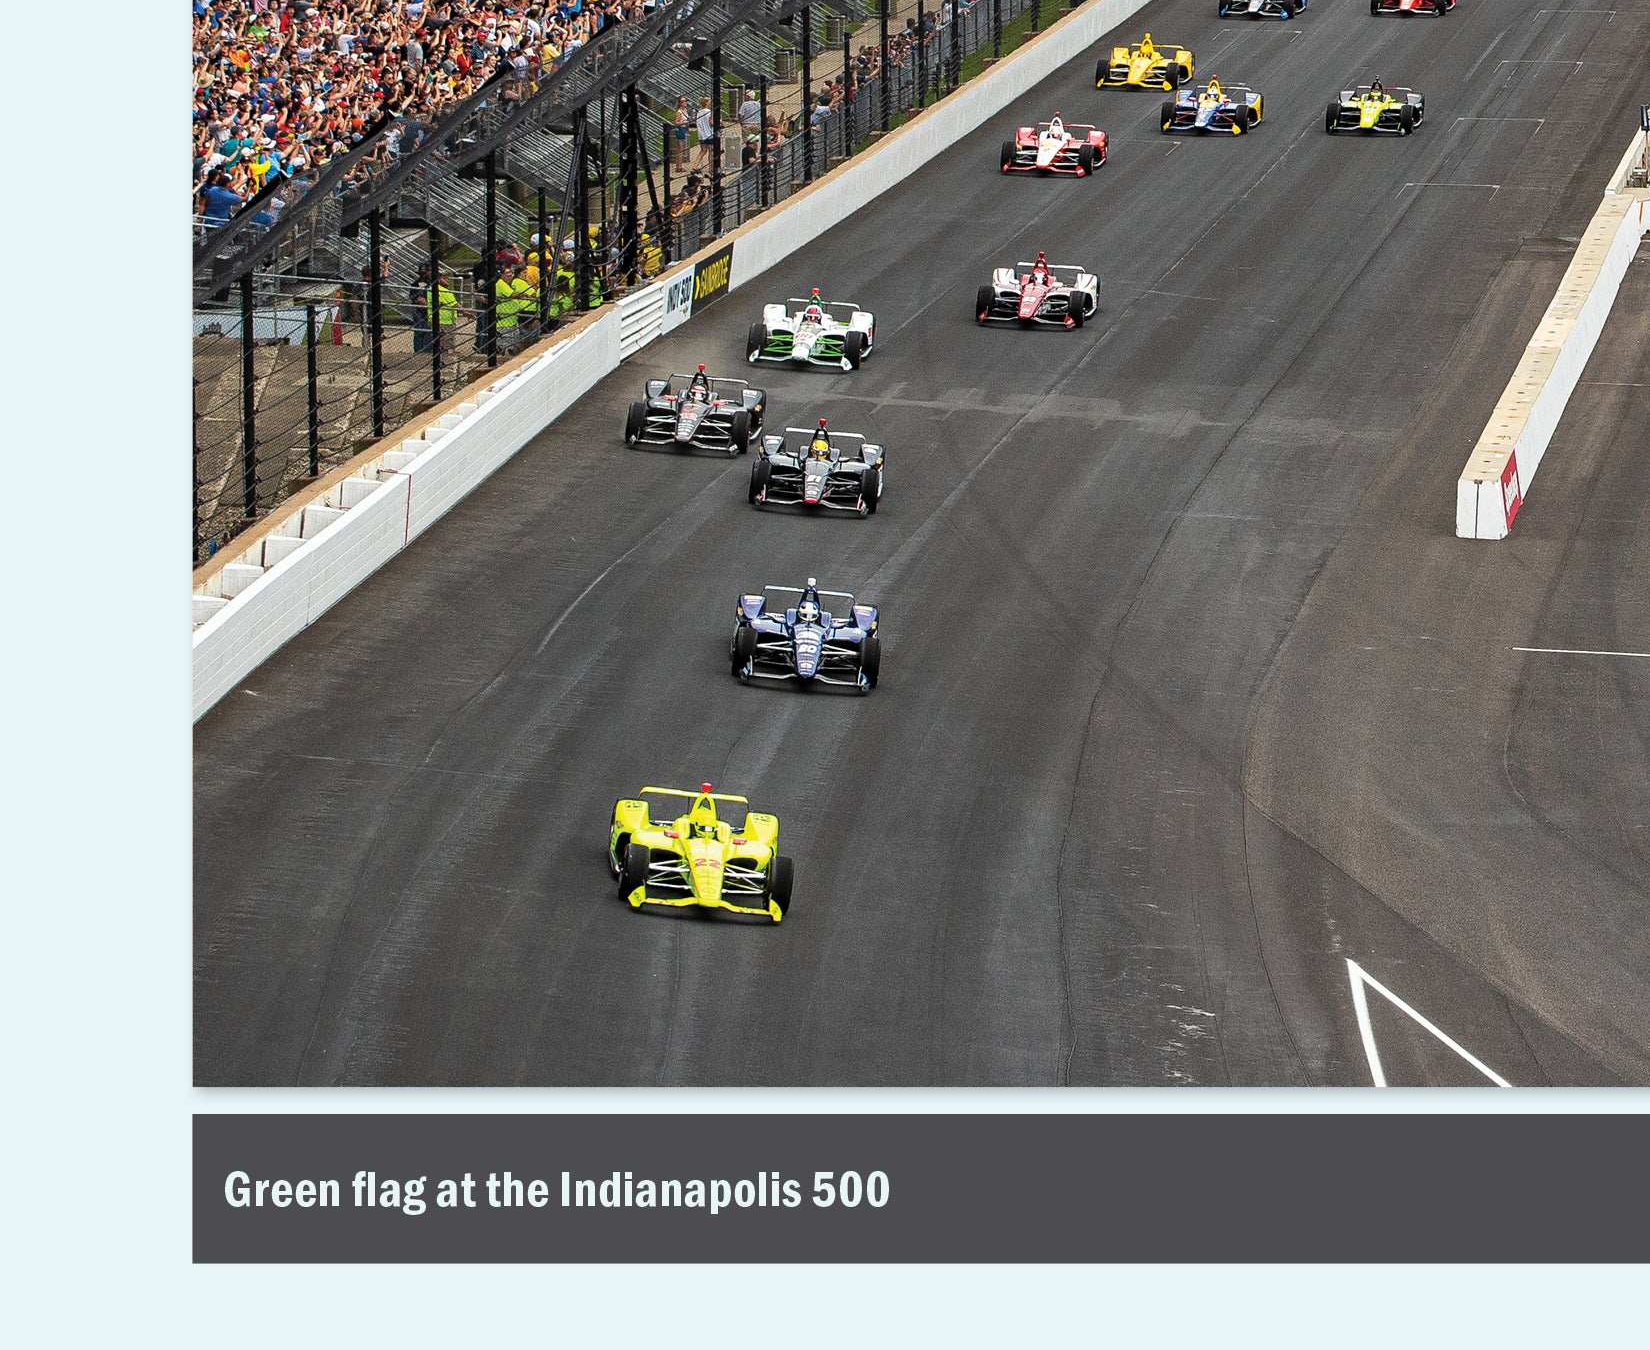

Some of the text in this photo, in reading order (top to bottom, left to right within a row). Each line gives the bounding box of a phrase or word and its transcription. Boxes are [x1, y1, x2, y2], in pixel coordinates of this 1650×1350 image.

[666, 275, 692, 314] INDY 500
[679, 412, 697, 421] 12
[797, 643, 817, 654] 20
[694, 857, 721, 869] 22
